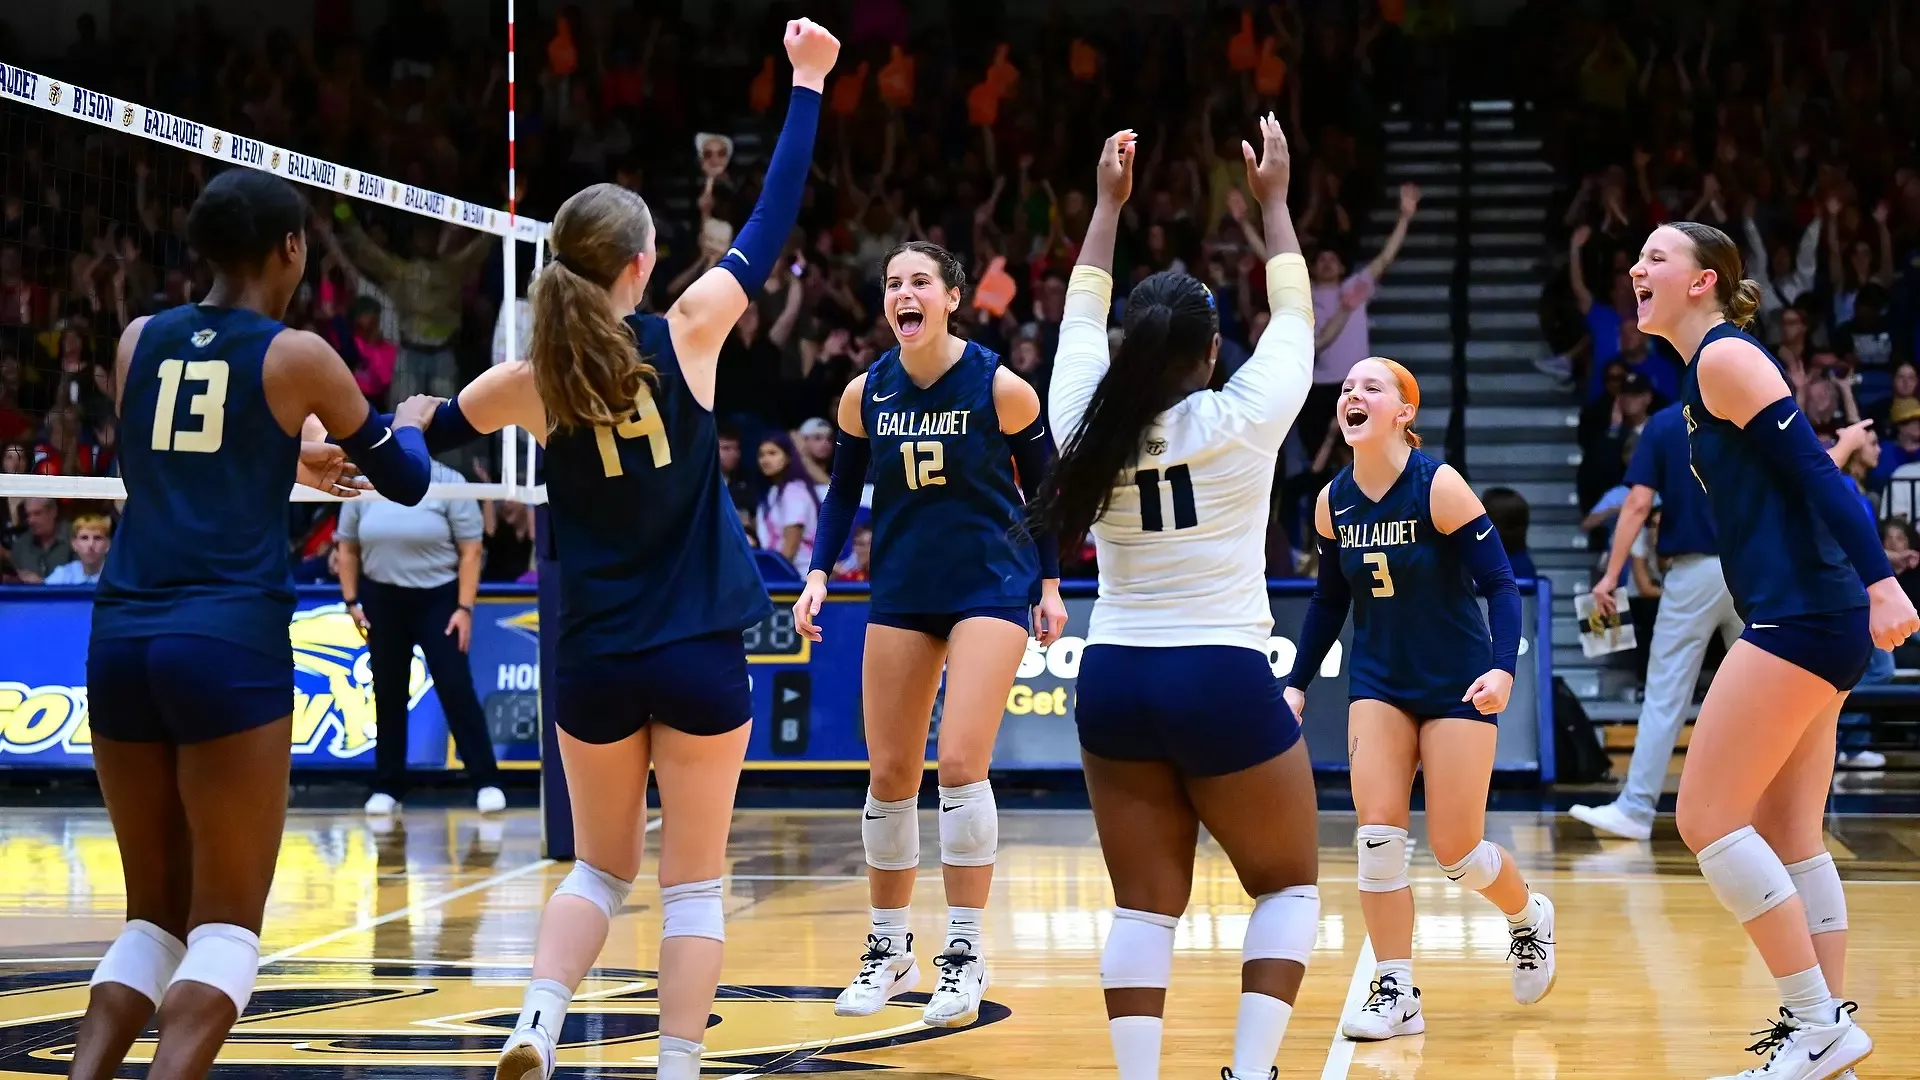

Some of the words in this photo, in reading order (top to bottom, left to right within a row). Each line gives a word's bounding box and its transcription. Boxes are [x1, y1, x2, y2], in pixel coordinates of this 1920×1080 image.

[73, 87, 114, 122] BISON
[144, 109, 204, 149] GALLAUDET
[231, 136, 265, 166] BISON
[288, 153, 337, 187] GALLAUDET
[358, 174, 385, 199] BISON
[405, 187, 445, 216] GALLAUDET
[463, 201, 485, 226] BISON
[151, 358, 229, 453] 13
[877, 410, 971, 436] GALLAUDET
[900, 441, 947, 490] 12
[1135, 463, 1198, 531] 11
[1338, 520, 1417, 549] GALLAUDET
[1363, 552, 1395, 598] 3
[1006, 684, 1067, 716] Get
